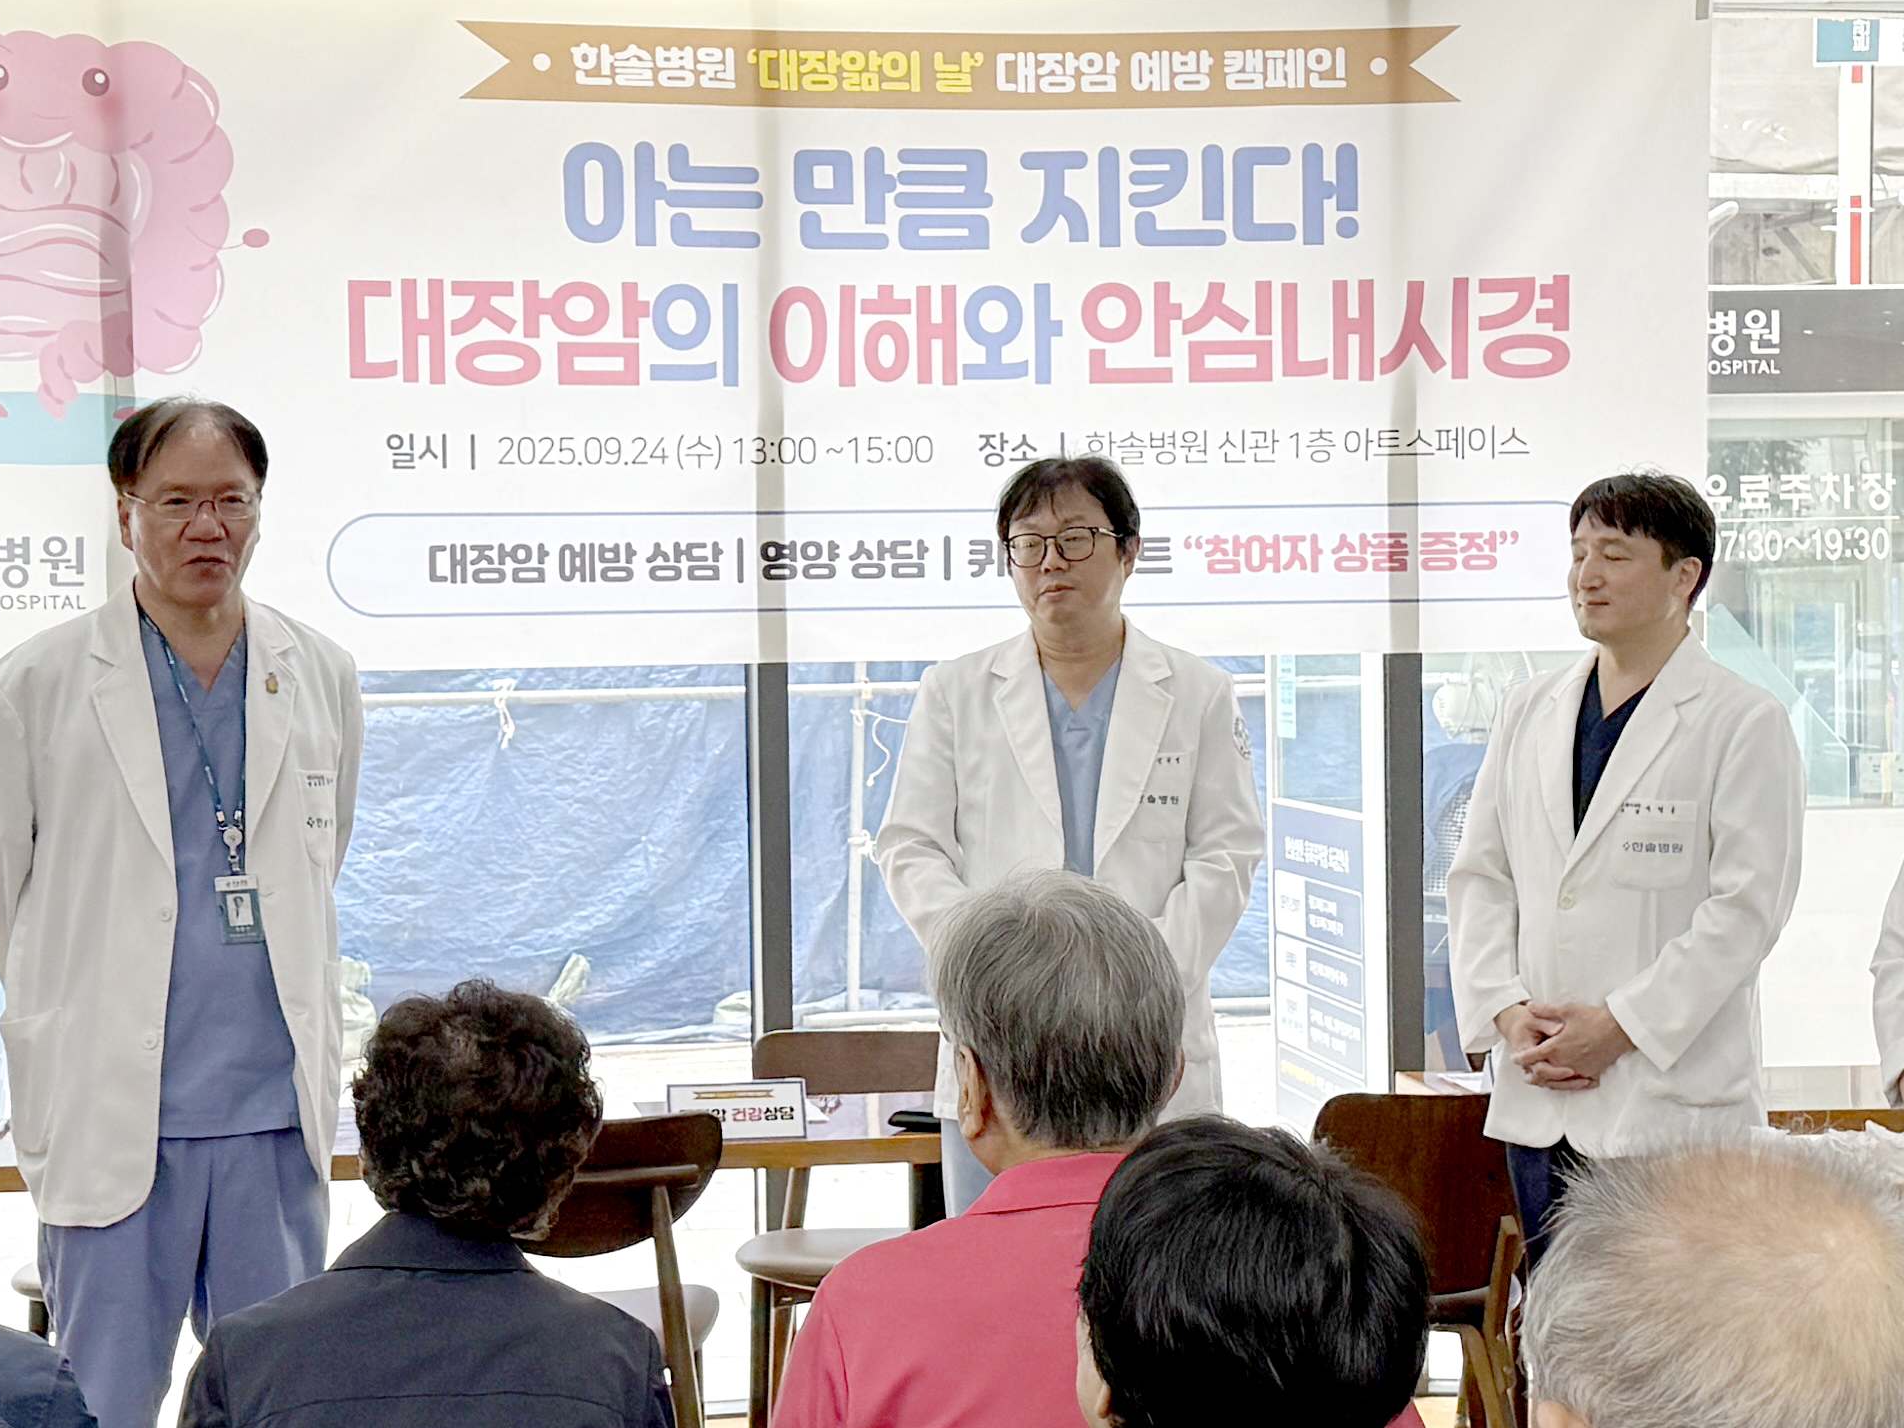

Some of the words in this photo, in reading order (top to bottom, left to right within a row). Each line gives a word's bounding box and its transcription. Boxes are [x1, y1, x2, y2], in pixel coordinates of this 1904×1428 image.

[570, 42, 737, 91] 한솔병원
[995, 50, 1122, 94] 대장암
[1129, 47, 1214, 93] 예방
[1222, 45, 1349, 92] 캠페인
[562, 140, 765, 249] 아는
[793, 145, 995, 251] 만큼
[1018, 141, 1361, 249] 지킨다!
[346, 278, 740, 388] 대장암의
[768, 281, 1064, 388] 이해와
[1080, 273, 1573, 386] 안심내시경
[1707, 308, 1781, 357] 병원
[384, 432, 449, 470] 일시
[496, 435, 670, 469] 2025.09.24
[676, 434, 723, 472] (수)
[734, 433, 818, 466] 13:00
[824, 433, 936, 466] ~15:00
[978, 431, 1039, 468] 장소
[1217, 427, 1280, 465] 신관
[1288, 427, 1336, 464] 1층
[1343, 424, 1531, 464] 아트스페이스
[1704, 471, 1897, 512] 유료주차장
[428, 542, 551, 585] 대장암
[558, 540, 639, 584] 예방
[645, 539, 725, 583] 상담
[759, 538, 842, 582] 영양
[848, 538, 931, 581] 상담
[1182, 532, 1323, 575] “참여자
[1330, 531, 1410, 573] 상품
[1417, 529, 1521, 573] 증정”
